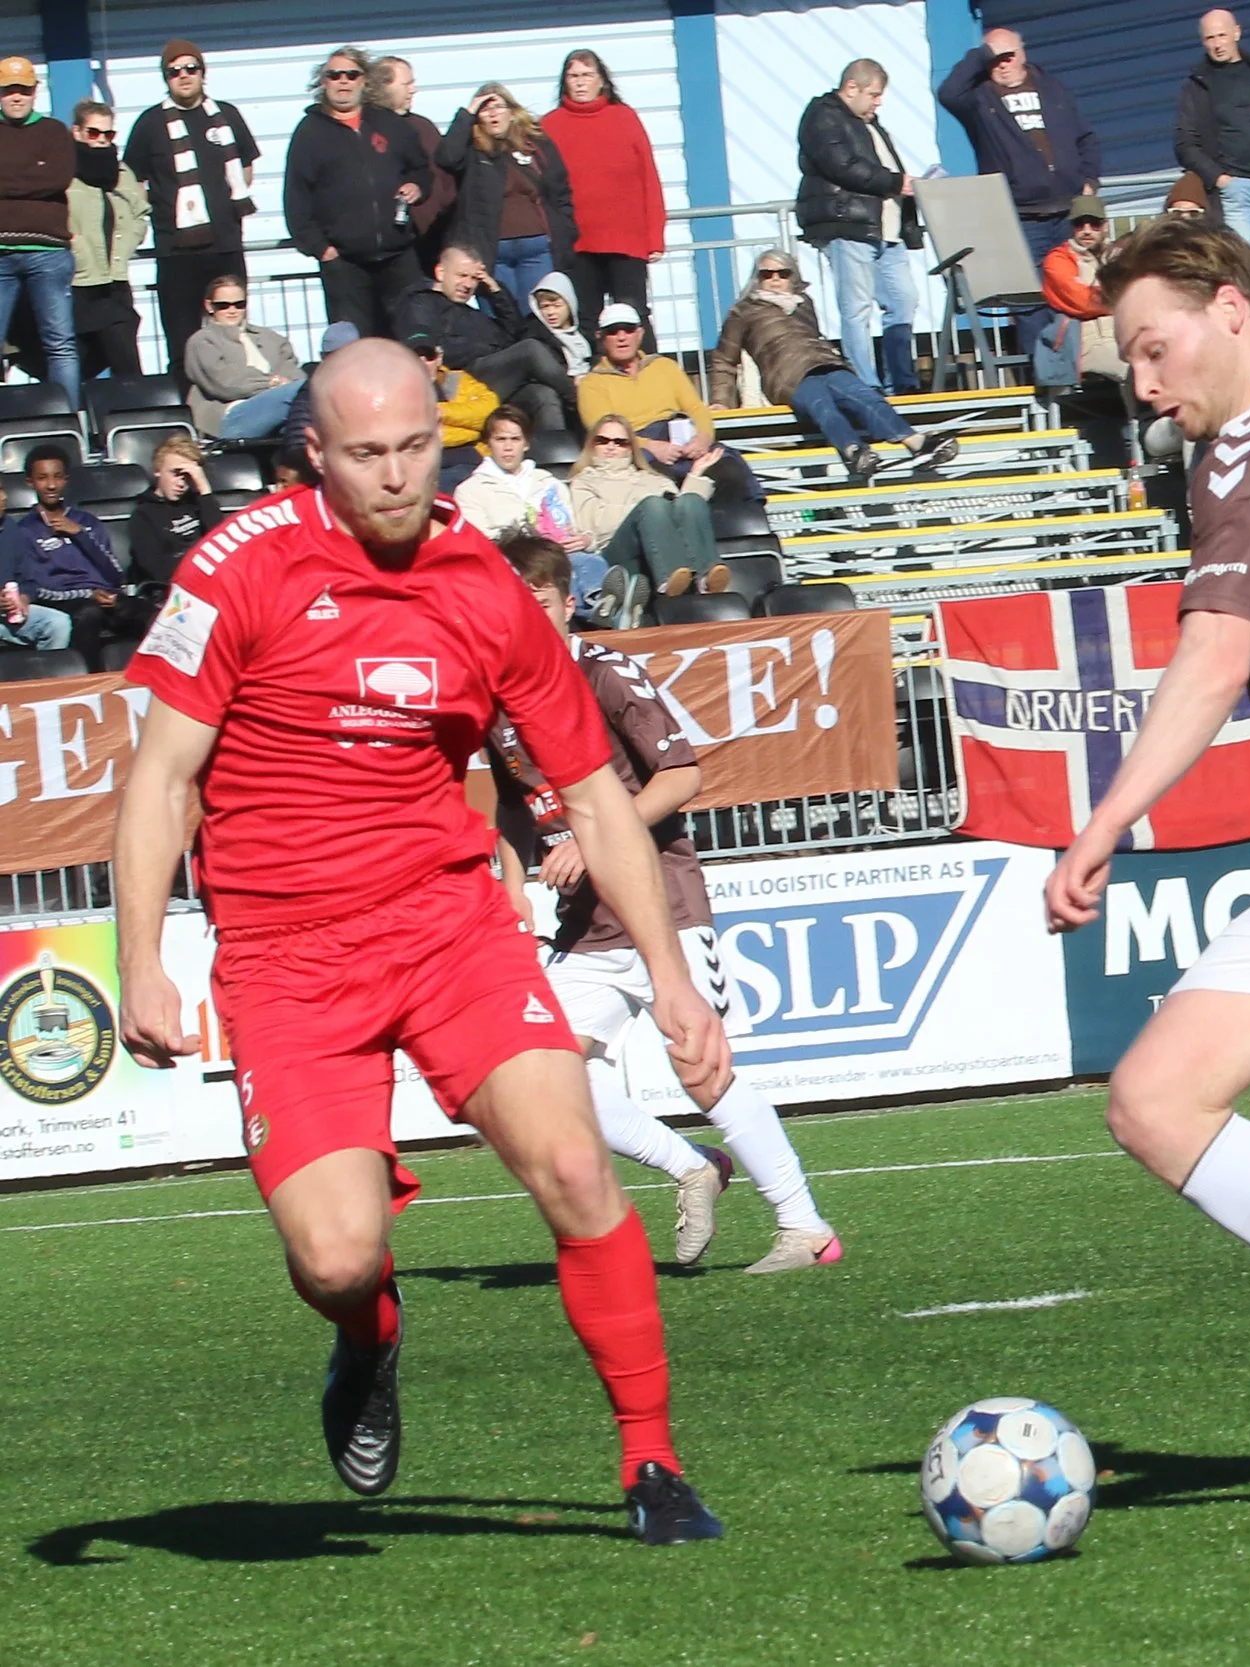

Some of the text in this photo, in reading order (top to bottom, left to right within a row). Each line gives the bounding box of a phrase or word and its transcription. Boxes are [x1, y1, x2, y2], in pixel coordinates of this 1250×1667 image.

[749, 869, 839, 896] LOGISTIC
[843, 864, 933, 888] PARTNER
[939, 861, 965, 879] AS
[717, 910, 919, 1026] SLP
[241, 1069, 253, 1107] 5
[117, 1109, 137, 1126] 41
